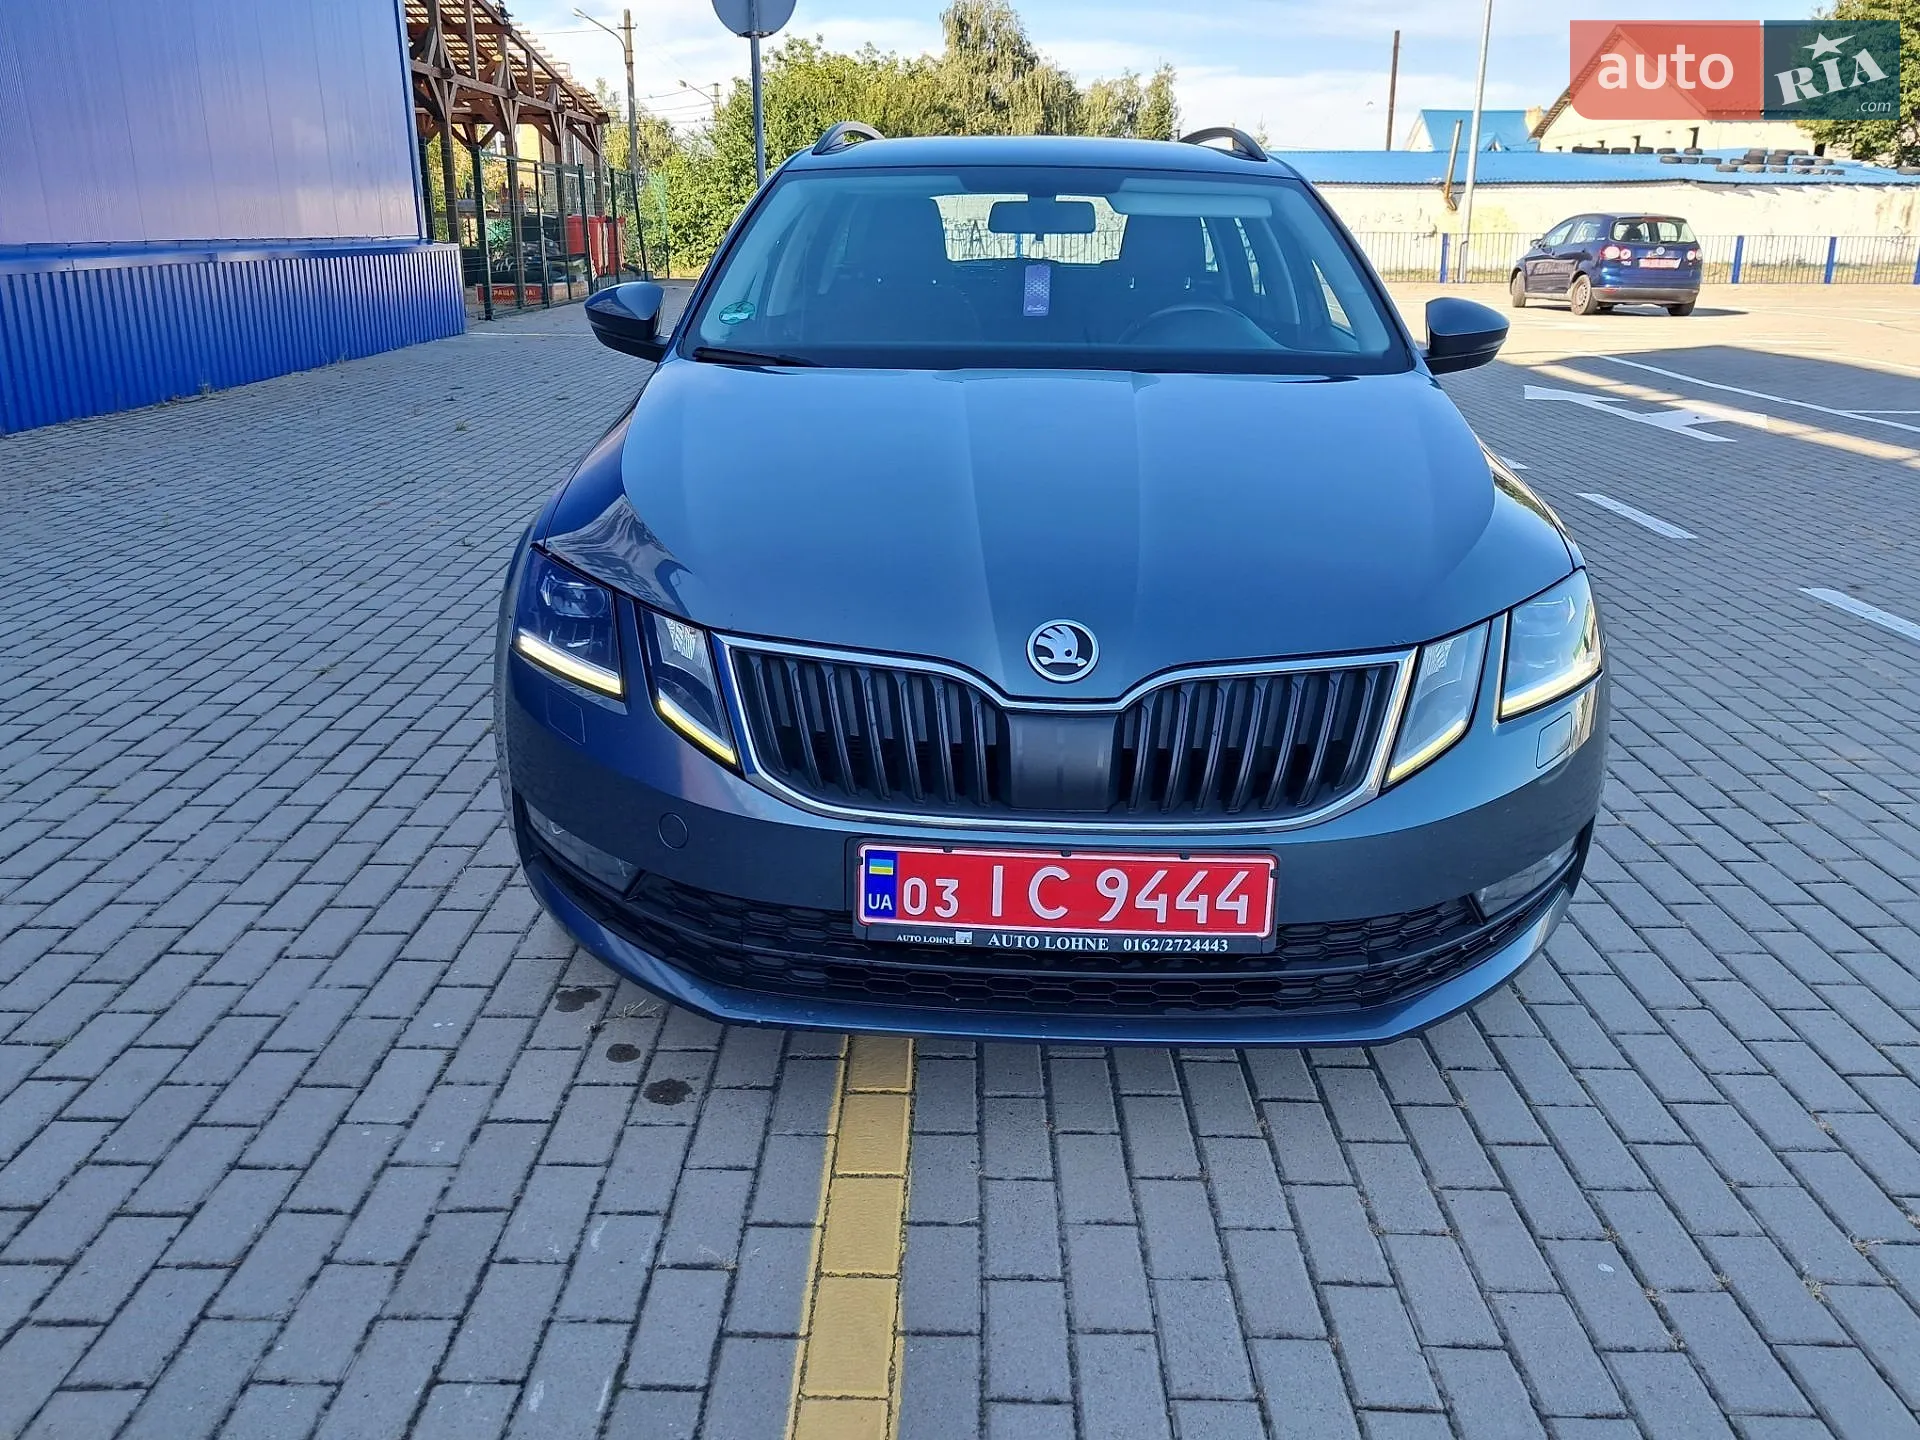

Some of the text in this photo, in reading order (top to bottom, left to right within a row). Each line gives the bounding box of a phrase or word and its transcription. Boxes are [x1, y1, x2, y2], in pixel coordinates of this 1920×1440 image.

[868, 894, 893, 911] UA
[902, 877, 959, 919] 03
[1095, 868, 1251, 925] 9444
[896, 934, 955, 945] AUTO LOHNE
[987, 934, 1229, 952] AUTO LOHNE 0162/2724443
